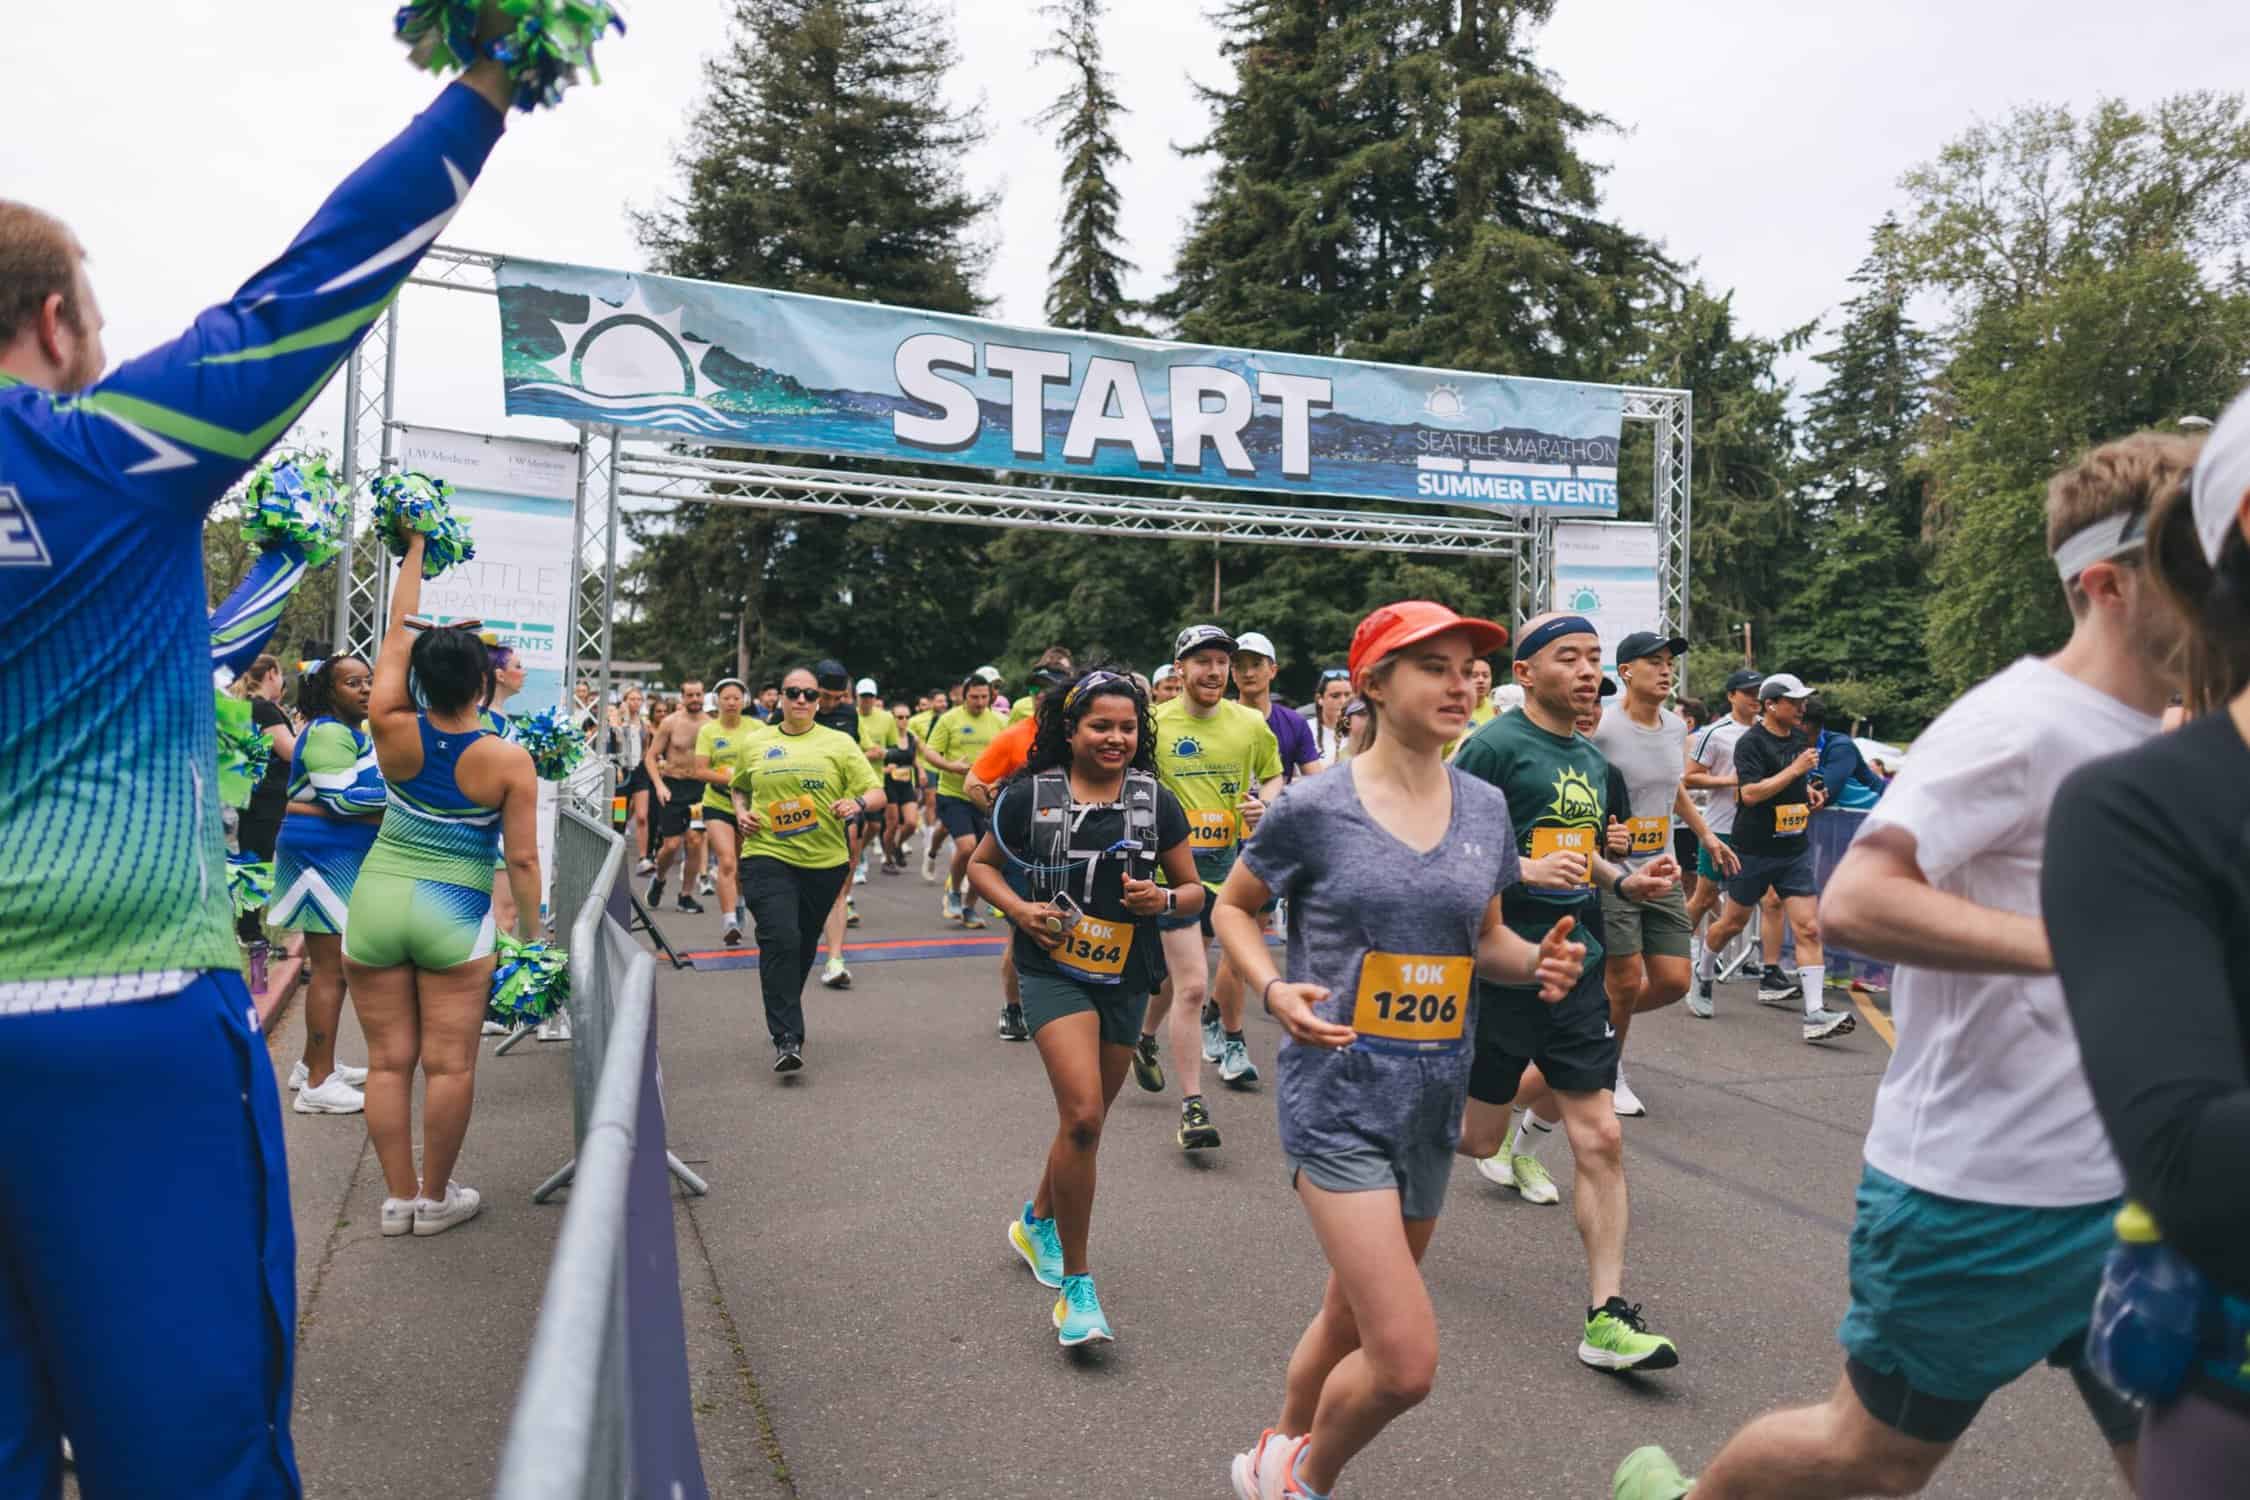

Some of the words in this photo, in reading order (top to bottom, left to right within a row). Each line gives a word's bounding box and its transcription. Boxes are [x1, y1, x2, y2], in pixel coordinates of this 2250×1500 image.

[892, 332, 1334, 482] START
[1416, 429, 1500, 456] SEATTLE
[1502, 436, 1618, 463] MARATHON
[1416, 472, 1526, 500] SUMMER
[1530, 479, 1618, 505] EVENTS
[775, 808, 811, 825] 1209
[1202, 812, 1224, 823] 10K
[1193, 826, 1230, 840] 1041
[1555, 832, 1583, 848] 10K
[1630, 831, 1664, 845] 1421
[1080, 921, 1114, 940] 10K
[1065, 936, 1121, 965] 1364
[1401, 963, 1446, 985] 10K
[1373, 991, 1458, 1024] 1206
